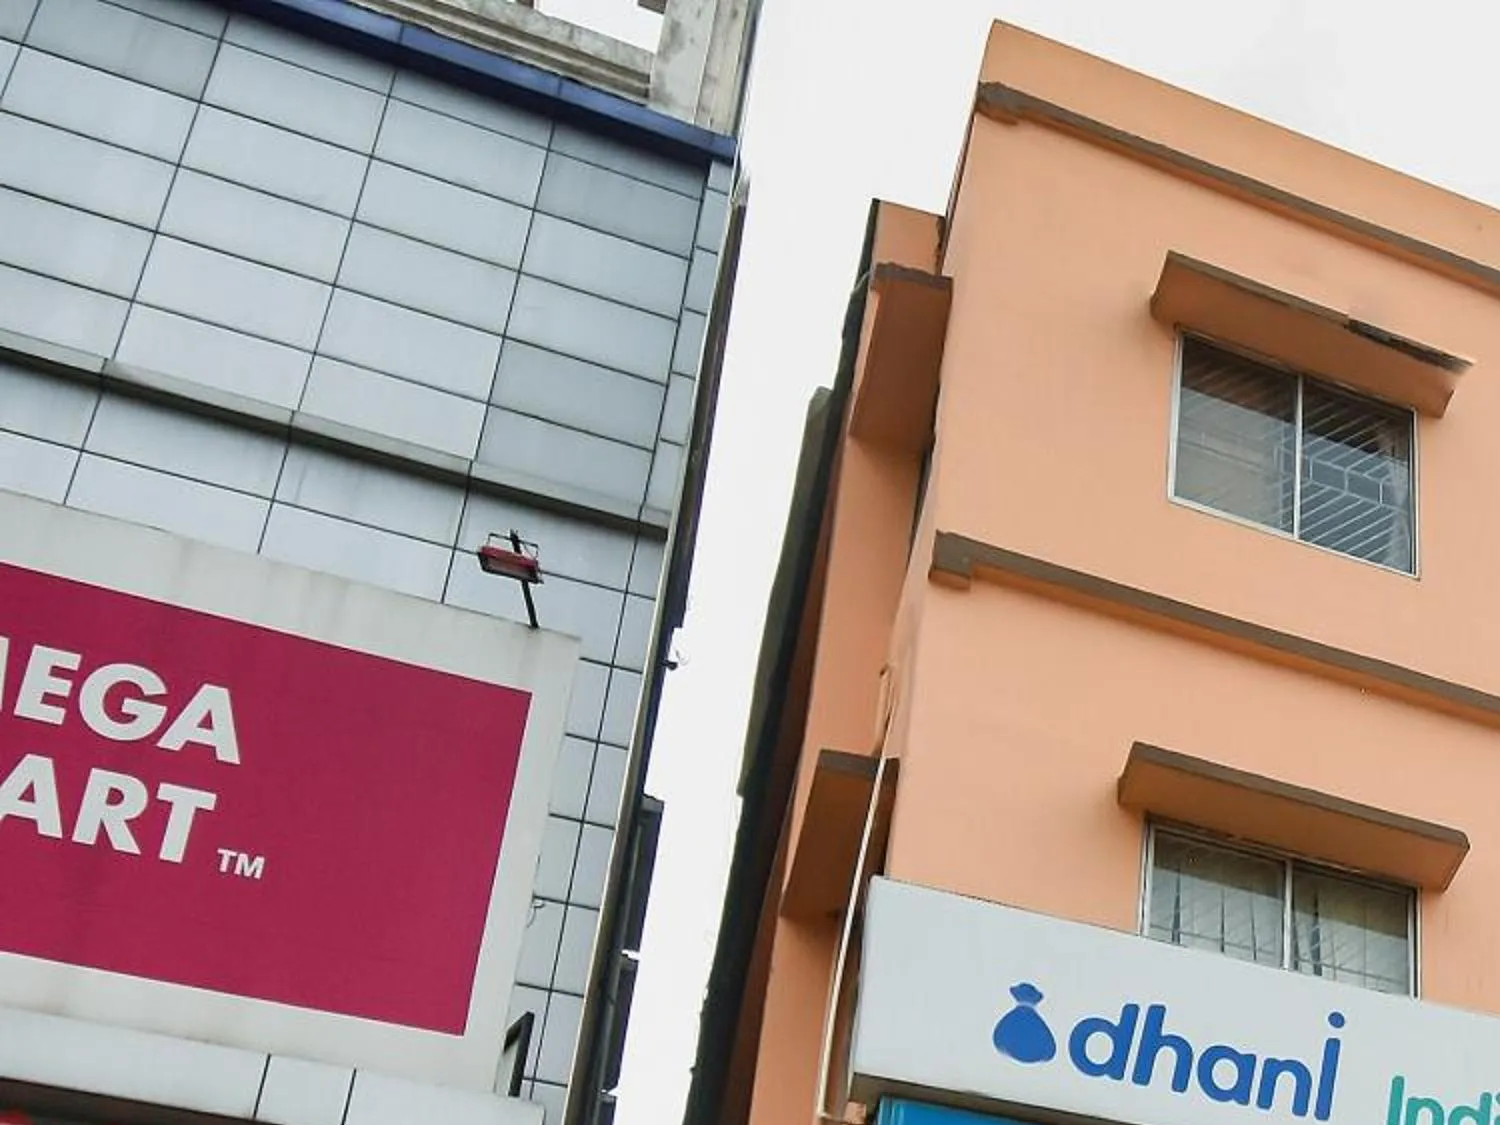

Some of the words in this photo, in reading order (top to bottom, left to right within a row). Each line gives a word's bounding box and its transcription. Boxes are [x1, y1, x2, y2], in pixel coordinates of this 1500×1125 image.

[0, 635, 240, 765] EGA
[217, 848, 265, 879] TM
[1068, 1003, 1345, 1121] dhani
